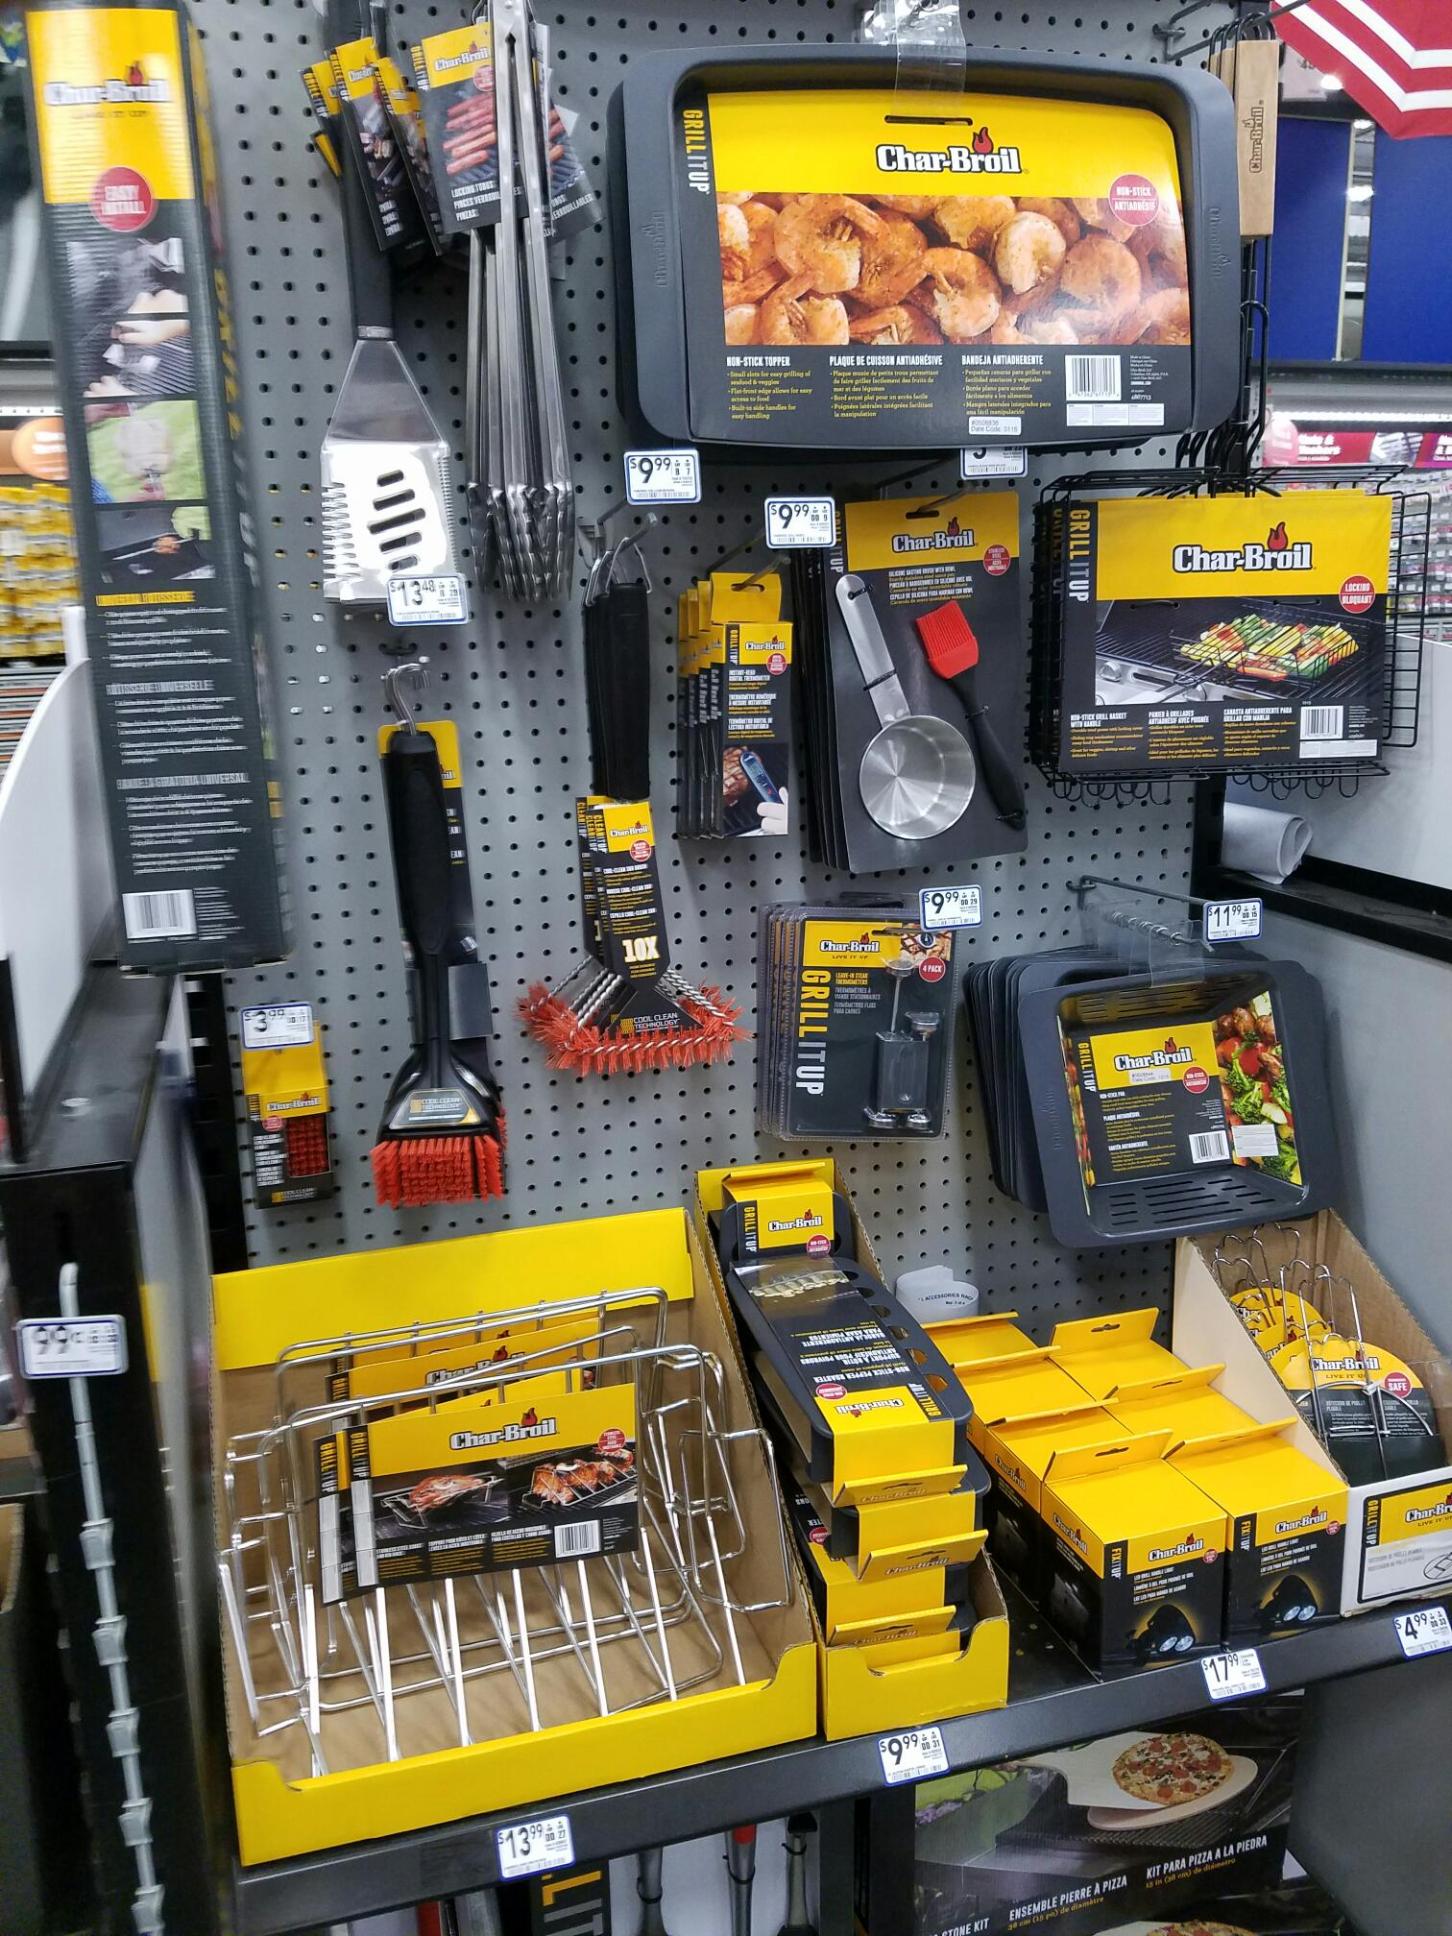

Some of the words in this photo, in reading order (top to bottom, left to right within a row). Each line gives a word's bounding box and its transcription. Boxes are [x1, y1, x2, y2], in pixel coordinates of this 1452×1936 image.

[683, 109, 706, 155] GRILL
[1248, 106, 1265, 174] Char-Broil
[687, 155, 707, 171] IT
[875, 144, 1023, 175] Char-Broil
[688, 170, 710, 194] UP
[726, 356, 764, 367] NON-STICK
[765, 356, 791, 367] TOPPER
[961, 354, 991, 366] BANDEJA
[993, 354, 1044, 366] ANTIADHERENTE
[891, 529, 976, 554] Char-Broil
[1069, 509, 1090, 560] GRILL
[1172, 541, 1313, 574] Char-Broil
[1069, 562, 1089, 577] IT
[1068, 579, 1090, 603] UP
[1345, 583, 1372, 593] LOCKING
[622, 936, 660, 963] 10X
[820, 940, 880, 953] Char-Broil
[923, 965, 927, 973] 4
[928, 965, 943, 974] PACK
[799, 970, 831, 1038] GRILL
[634, 1019, 678, 1030] TECHNOLOGY
[654, 1012, 678, 1020] CLEAN
[797, 1041, 827, 1063] IT
[1113, 1047, 1194, 1071] Char-Broil
[795, 1065, 826, 1096] UP
[744, 1206, 756, 1232] GRILL
[768, 1216, 822, 1233] Char-Broil
[745, 1231, 757, 1241] IT
[745, 1240, 757, 1253] UP
[813, 1374, 845, 1384] ROASTER
[845, 1371, 872, 1380] PEPPER
[873, 1366, 910, 1377] NON-STICK
[1387, 1382, 1407, 1392] SAFE
[835, 1398, 904, 1414] Char-Broil
[448, 1416, 558, 1450] Char-Broil
[351, 1431, 368, 1459] GRILL
[320, 1441, 336, 1472] GRILL
[352, 1458, 368, 1468] IT
[321, 1471, 336, 1481] IT
[353, 1467, 369, 1478] UP
[322, 1480, 338, 1494] UP
[1275, 1511, 1328, 1534] Char-Broil
[1148, 1539, 1204, 1562] Char-Broil
[1146, 1863, 1161, 1879] KIT
[1163, 1858, 1186, 1875] PARA
[1188, 1851, 1213, 1870] PIZZA
[1215, 1849, 1222, 1863] A
[1224, 1846, 1235, 1859] LA
[1236, 1835, 1268, 1857] PIEDRA
[1009, 1895, 1058, 1922] ENSEMBLE
[1059, 1885, 1092, 1905] PIERRE
[1094, 1881, 1101, 1896] À
[1102, 1874, 1128, 1893] PIZZA
[974, 1917, 990, 1933] KIT
